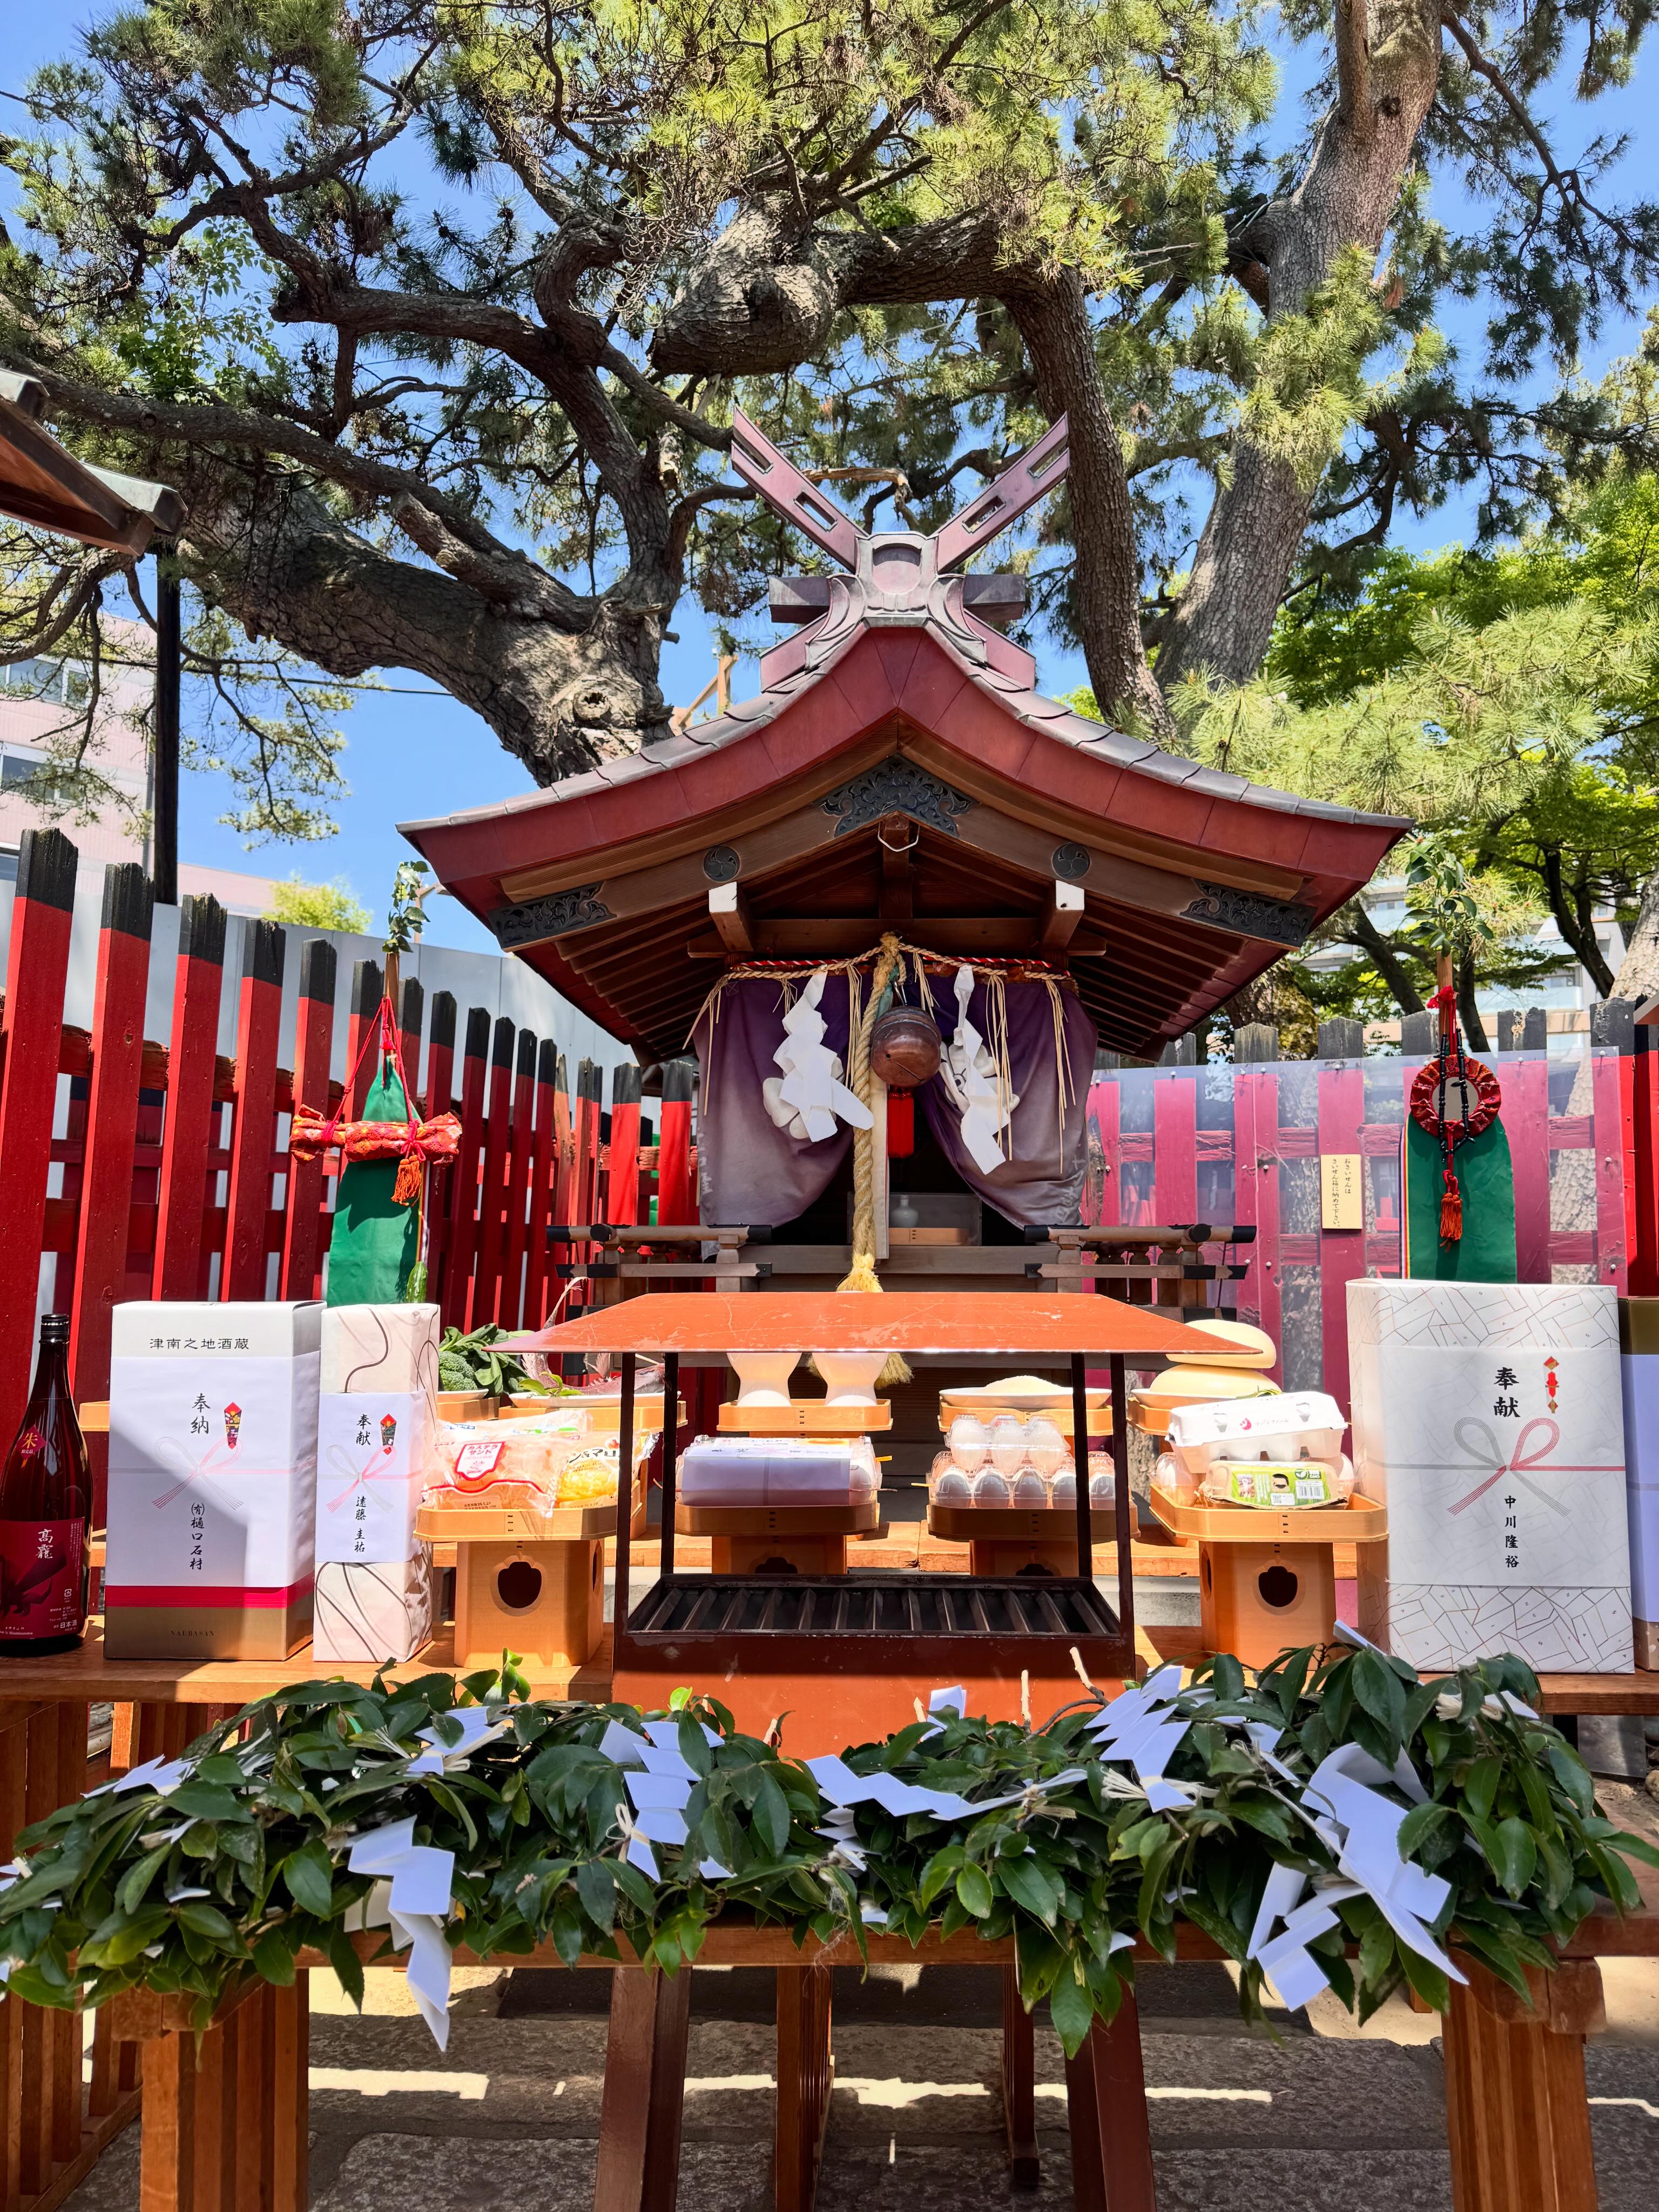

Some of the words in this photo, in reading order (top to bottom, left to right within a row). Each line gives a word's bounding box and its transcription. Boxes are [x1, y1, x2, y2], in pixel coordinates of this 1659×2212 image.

[150, 1338, 249, 1350] 津南之地酒蔵
[1493, 1367, 1521, 1418] 奉献
[191, 1393, 211, 1434] 奉納
[356, 1414, 372, 1446] 奉献
[22, 1433, 38, 1449] 朱
[1504, 1495, 1520, 1568] 中川隆裕
